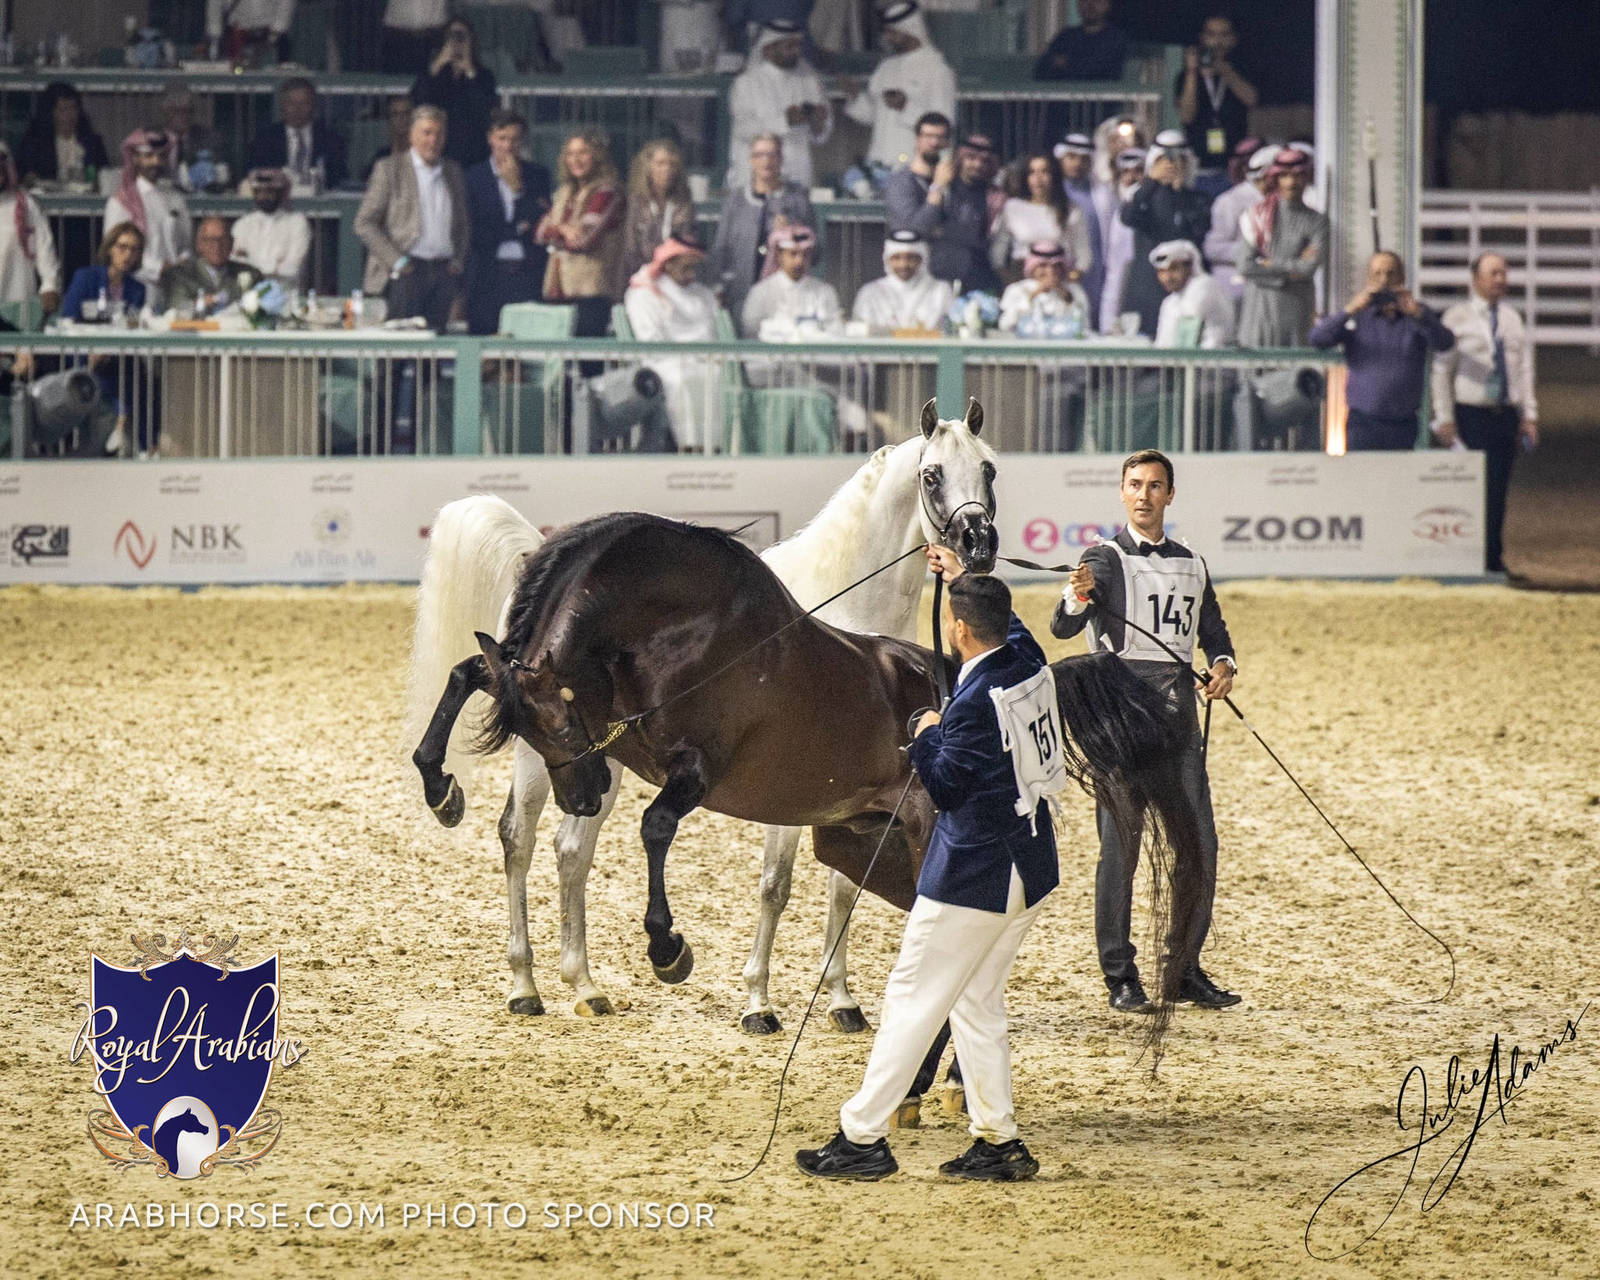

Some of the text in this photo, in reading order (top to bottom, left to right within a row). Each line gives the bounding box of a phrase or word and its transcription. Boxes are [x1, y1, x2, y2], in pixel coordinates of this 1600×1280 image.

[172, 524, 243, 550] NBK
[1222, 517, 1363, 541] ZOOM
[1147, 593, 1196, 637] 143
[1028, 706, 1058, 766] 151
